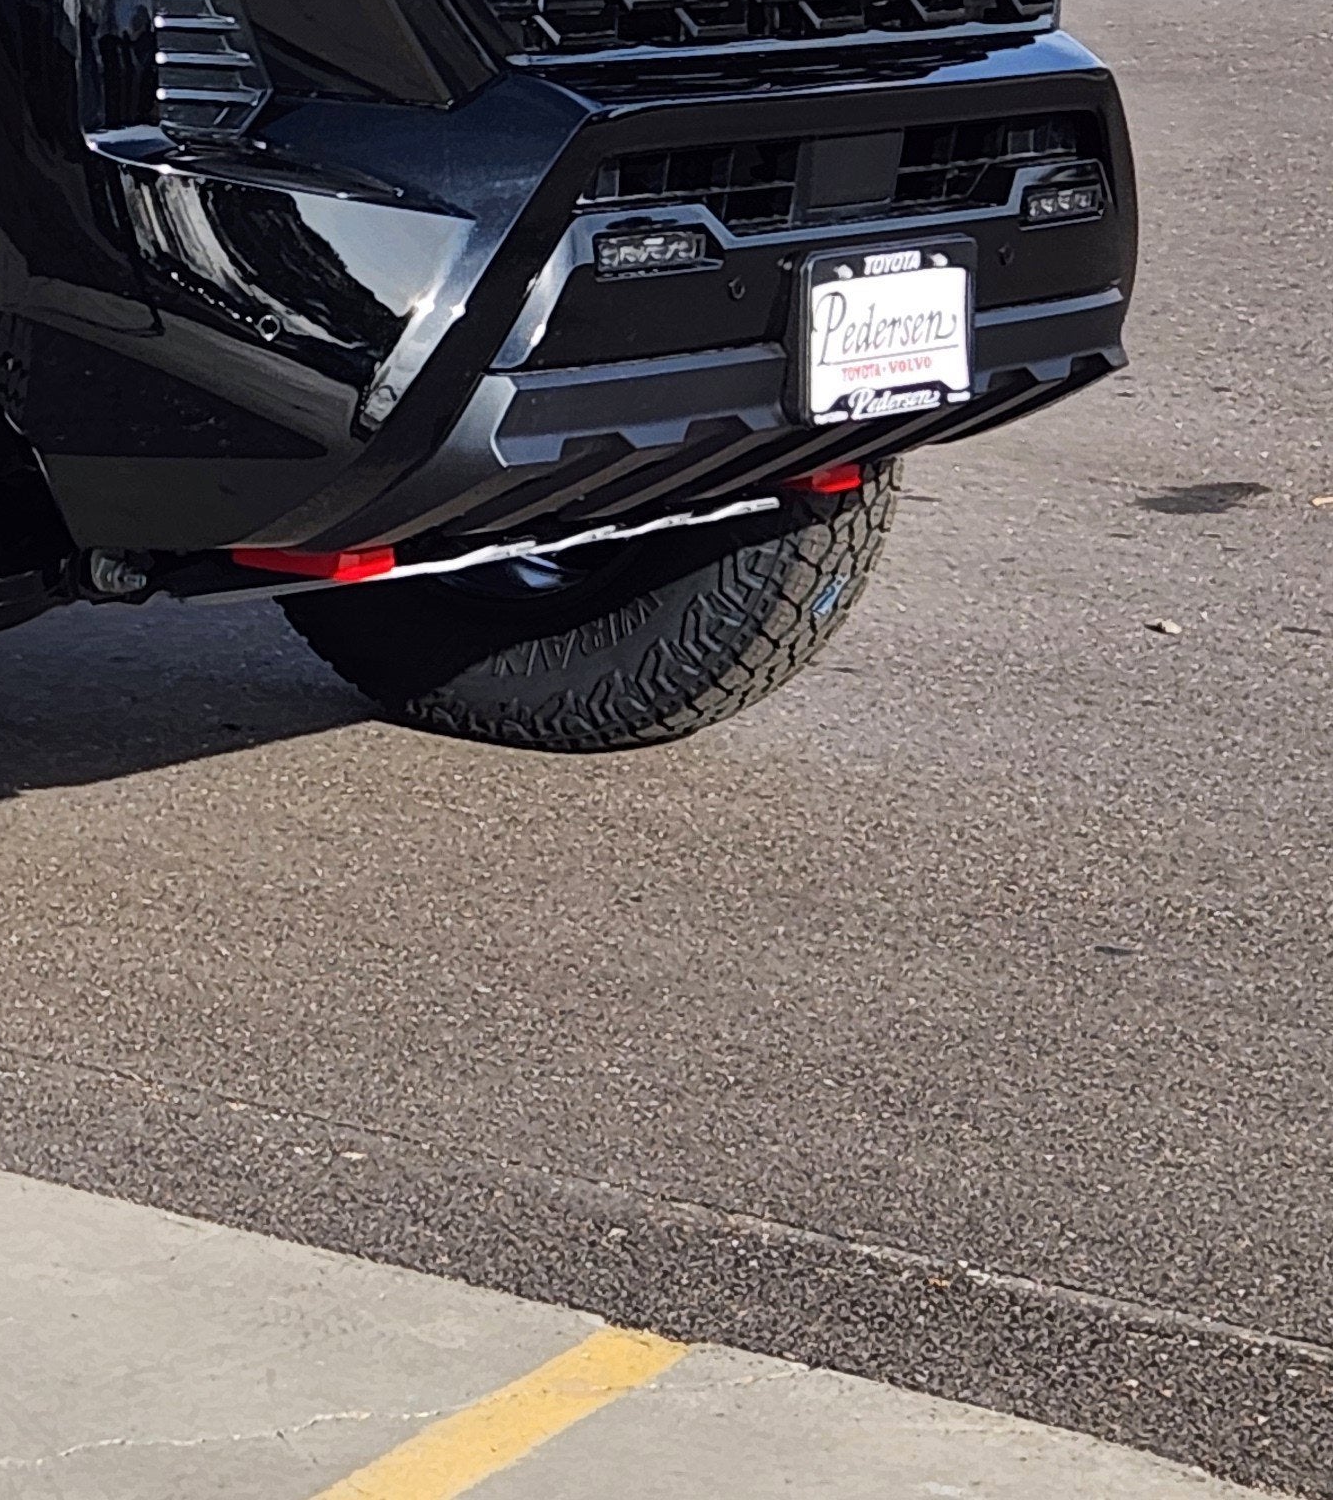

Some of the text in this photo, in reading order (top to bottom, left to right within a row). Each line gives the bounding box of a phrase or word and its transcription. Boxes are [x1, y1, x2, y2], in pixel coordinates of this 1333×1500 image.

[863, 250, 921, 276] TOYOTA
[812, 291, 958, 367] Pedersen
[841, 355, 933, 382] TOYOTA VOLVO
[847, 387, 942, 421] Pedersen
